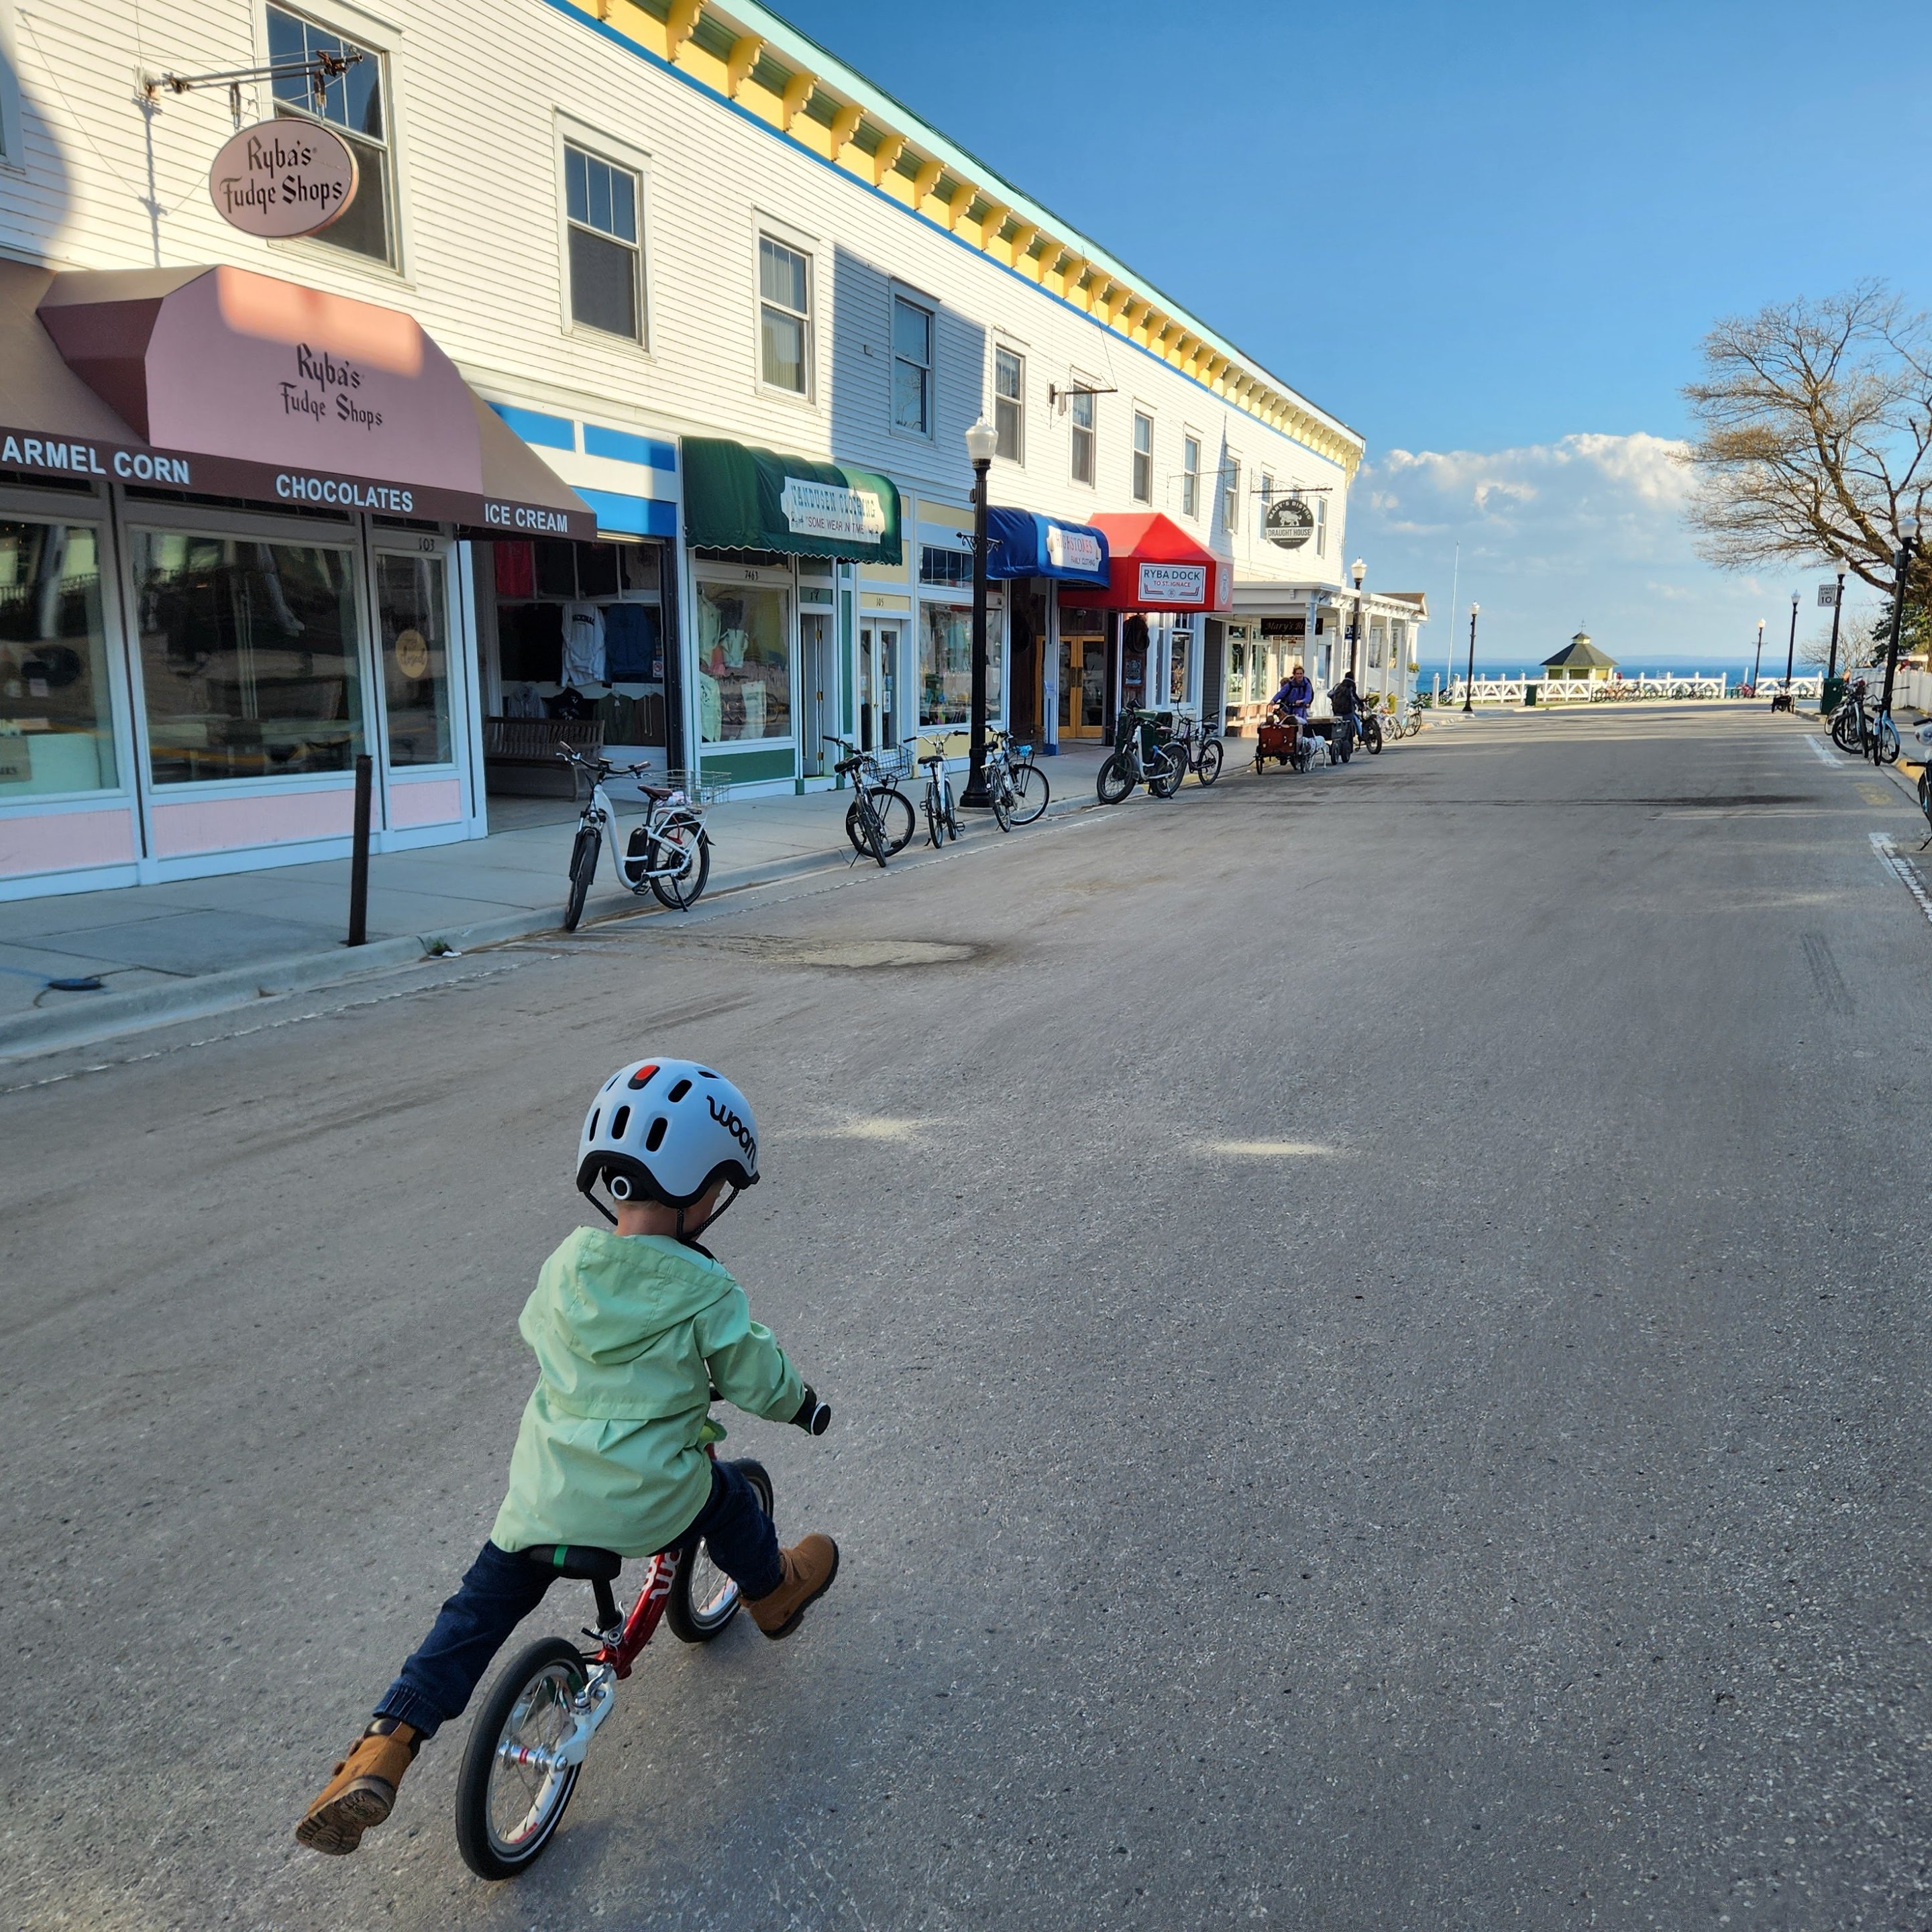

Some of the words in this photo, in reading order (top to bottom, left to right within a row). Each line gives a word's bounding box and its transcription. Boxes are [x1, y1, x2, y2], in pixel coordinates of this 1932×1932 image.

[247, 135, 312, 179] Ryba's
[219, 176, 276, 215] Fudge
[282, 174, 343, 210] Shops
[297, 342, 361, 393] Ryba's
[278, 382, 326, 423] Fudge
[336, 392, 383, 431] Shops
[113, 451, 191, 485] CORN
[276, 474, 413, 513] CHOCOLATES
[839, 493, 875, 518] CLOTHING
[484, 503, 511, 525] ICE
[515, 508, 568, 533] CREAM
[1269, 501, 1290, 520] MARY'S
[1291, 500, 1312, 520] BISTRO
[826, 519, 843, 532] WEAR
[844, 522, 851, 532] IN
[1293, 529, 1311, 537] HOUSE
[419, 537, 435, 552] 103
[1144, 569, 1169, 580] RYBA
[1172, 571, 1201, 581] DOCK
[1265, 621, 1294, 633] Mary's
[706, 1094, 757, 1170] woom
